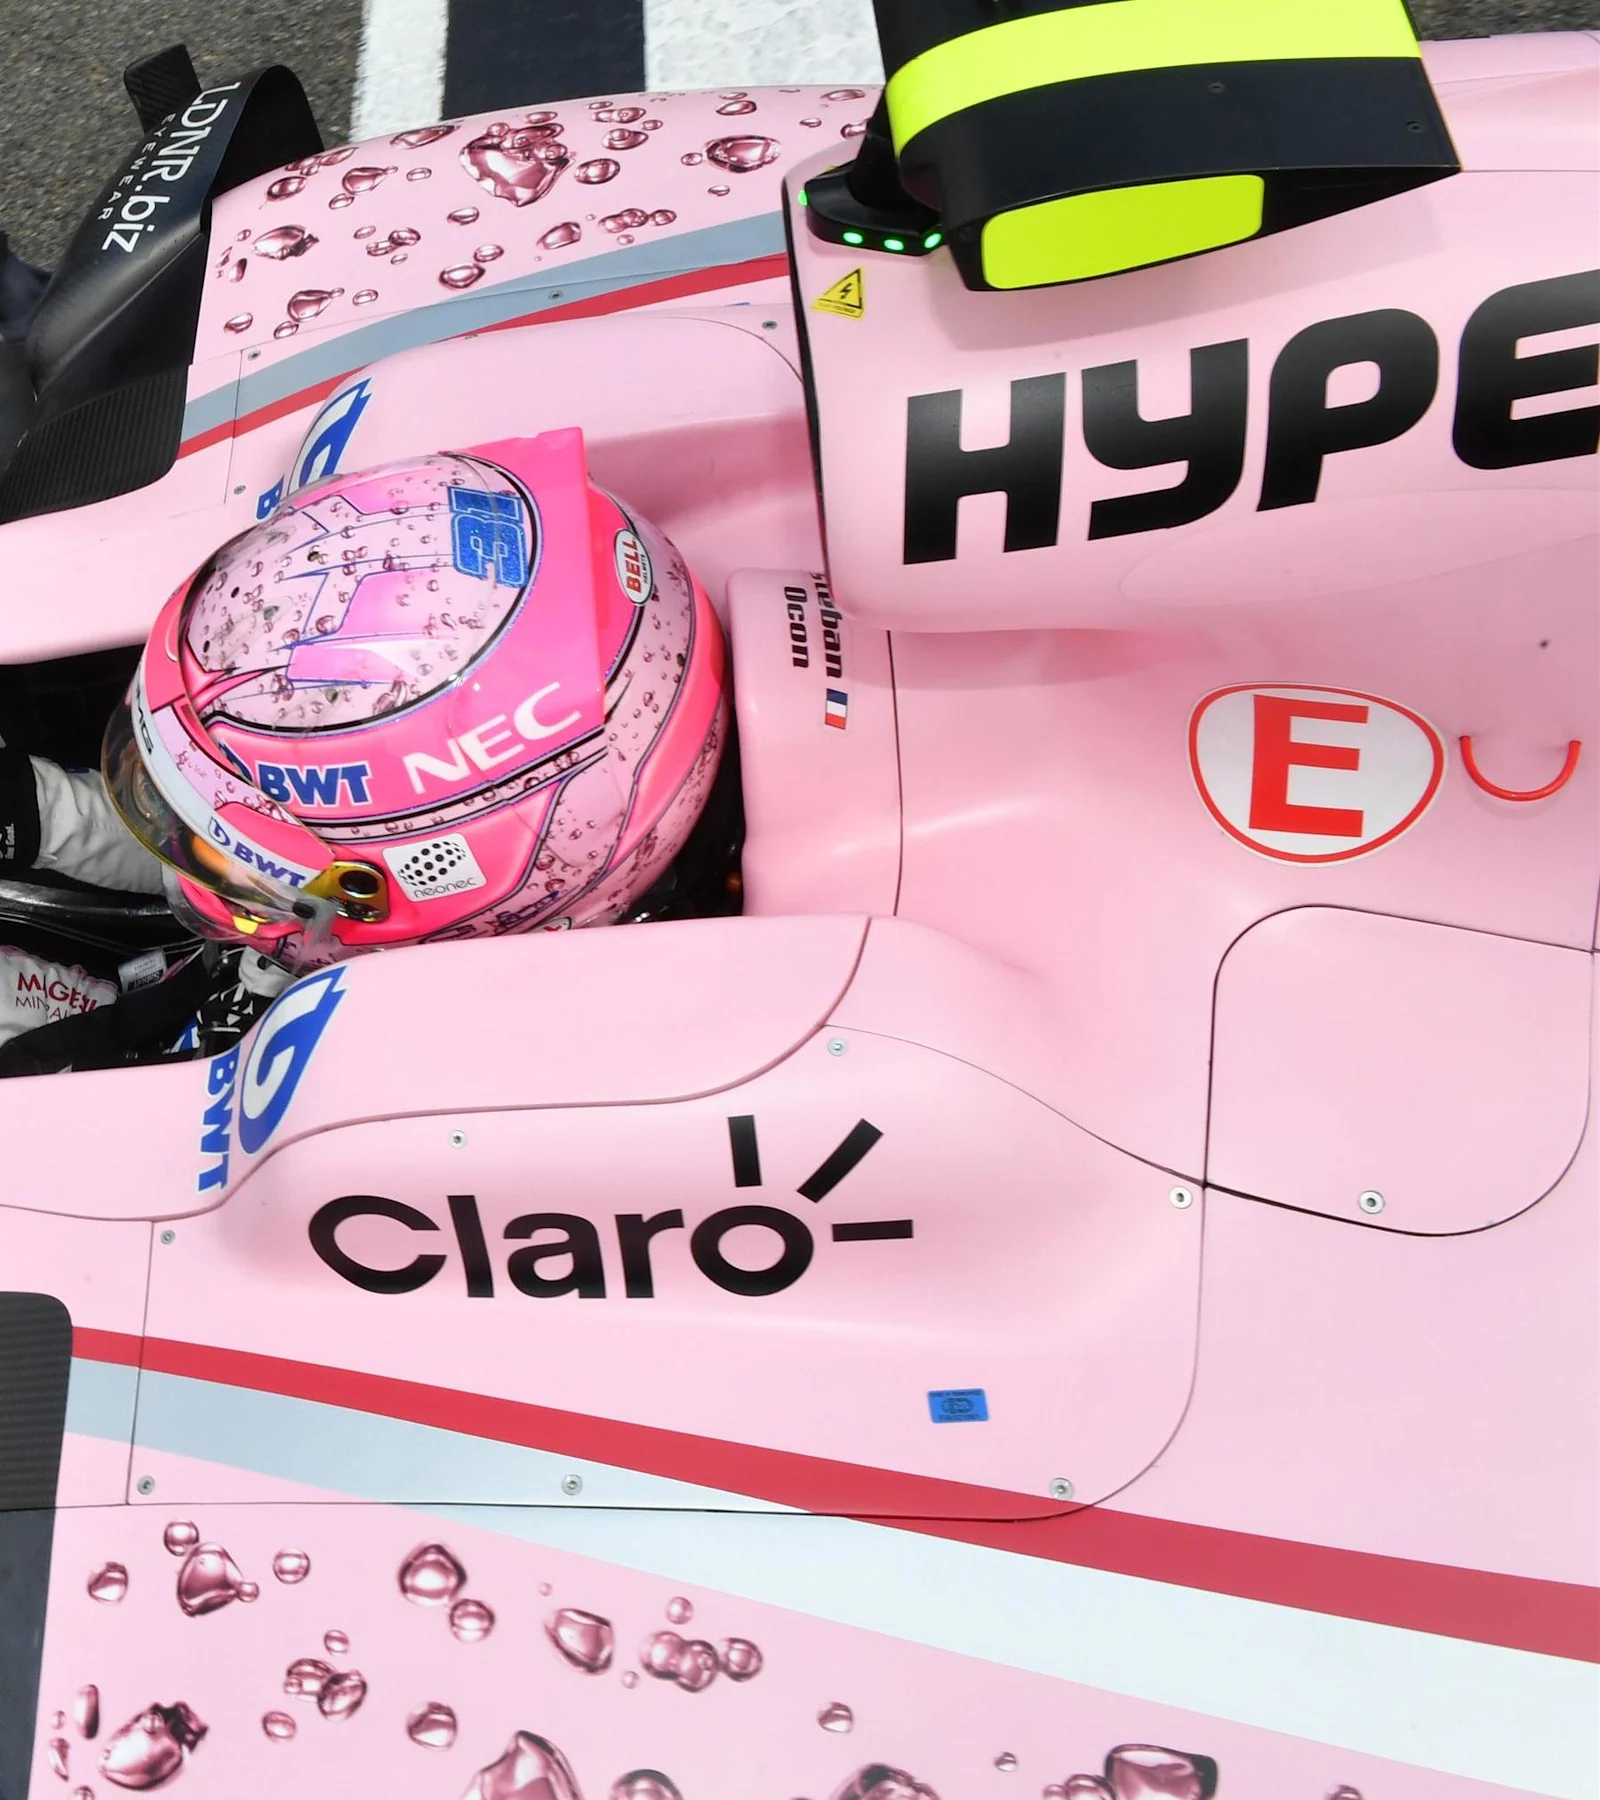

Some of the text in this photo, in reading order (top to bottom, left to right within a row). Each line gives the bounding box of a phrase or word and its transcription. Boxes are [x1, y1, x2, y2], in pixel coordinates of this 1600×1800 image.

[97, 113, 178, 223] EYEWEAR
[101, 81, 242, 254] LDNR.biz
[902, 269, 1600, 565] HYPE
[448, 486, 529, 589] 31
[621, 539, 642, 594] BELL
[784, 586, 809, 669] Ocon
[259, 764, 372, 806] BWT
[402, 682, 582, 795] NEC
[1249, 694, 1370, 838] E
[232, 840, 308, 889] BWT
[413, 875, 477, 899] neonec
[197, 1046, 241, 1193] BWT
[307, 1193, 815, 1300] Claro
